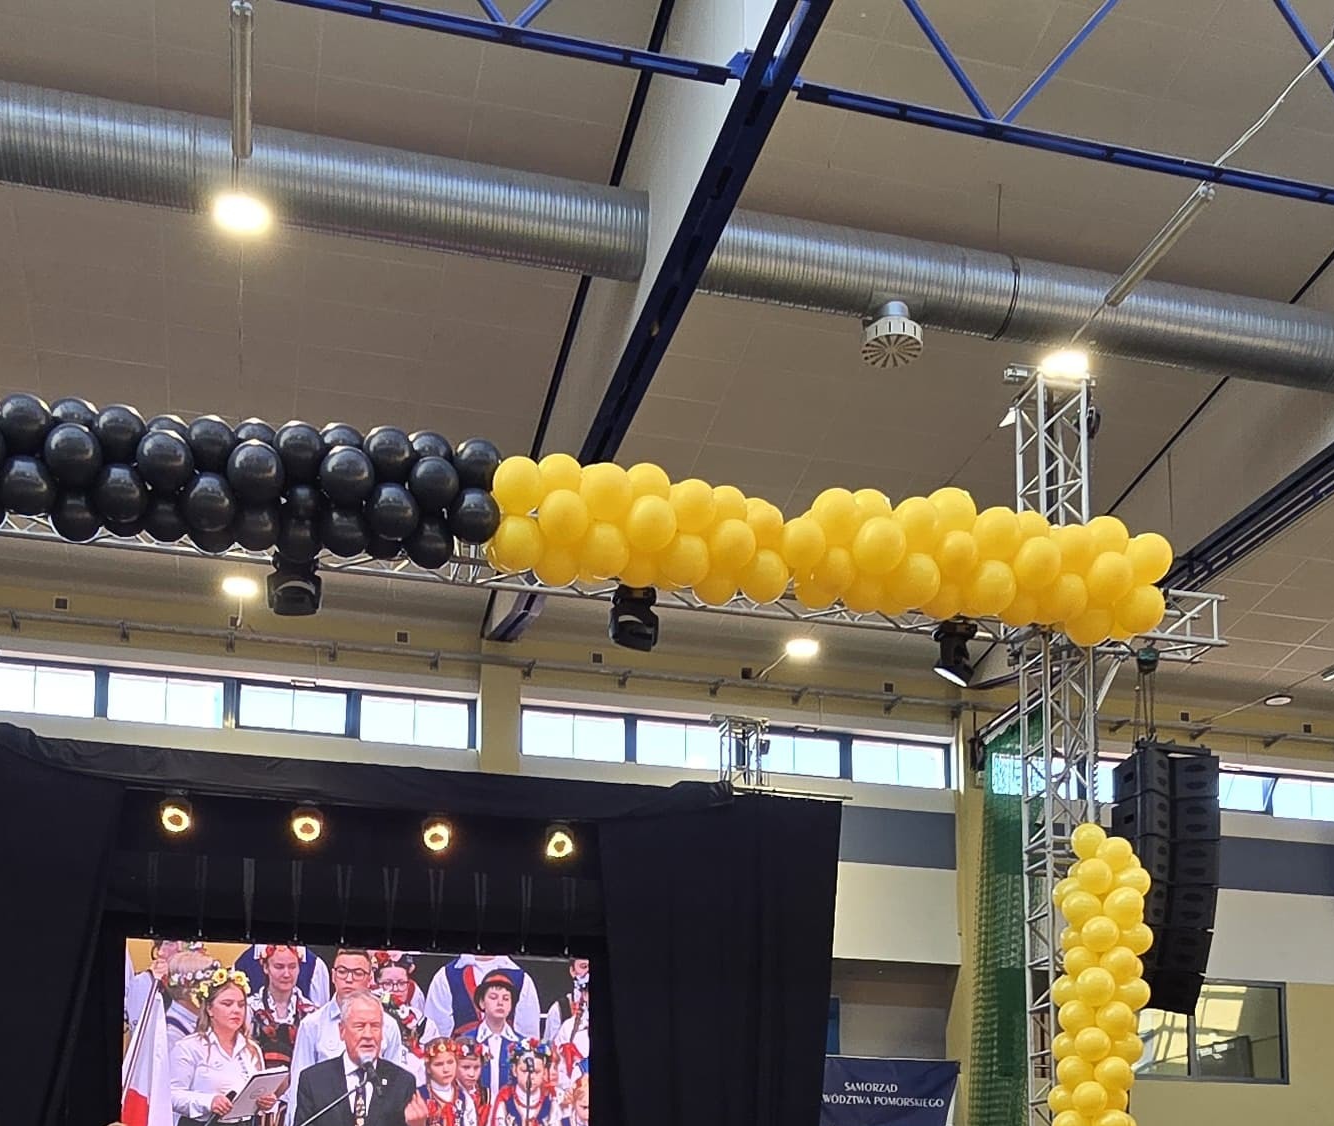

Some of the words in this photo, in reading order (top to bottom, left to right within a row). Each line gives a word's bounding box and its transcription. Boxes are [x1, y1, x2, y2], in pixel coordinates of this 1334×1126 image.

[844, 1081, 898, 1093] SAMORZĄD
[822, 1093, 871, 1105] WÓDZTWA
[874, 1096, 945, 1108] POMORSKIEGO
